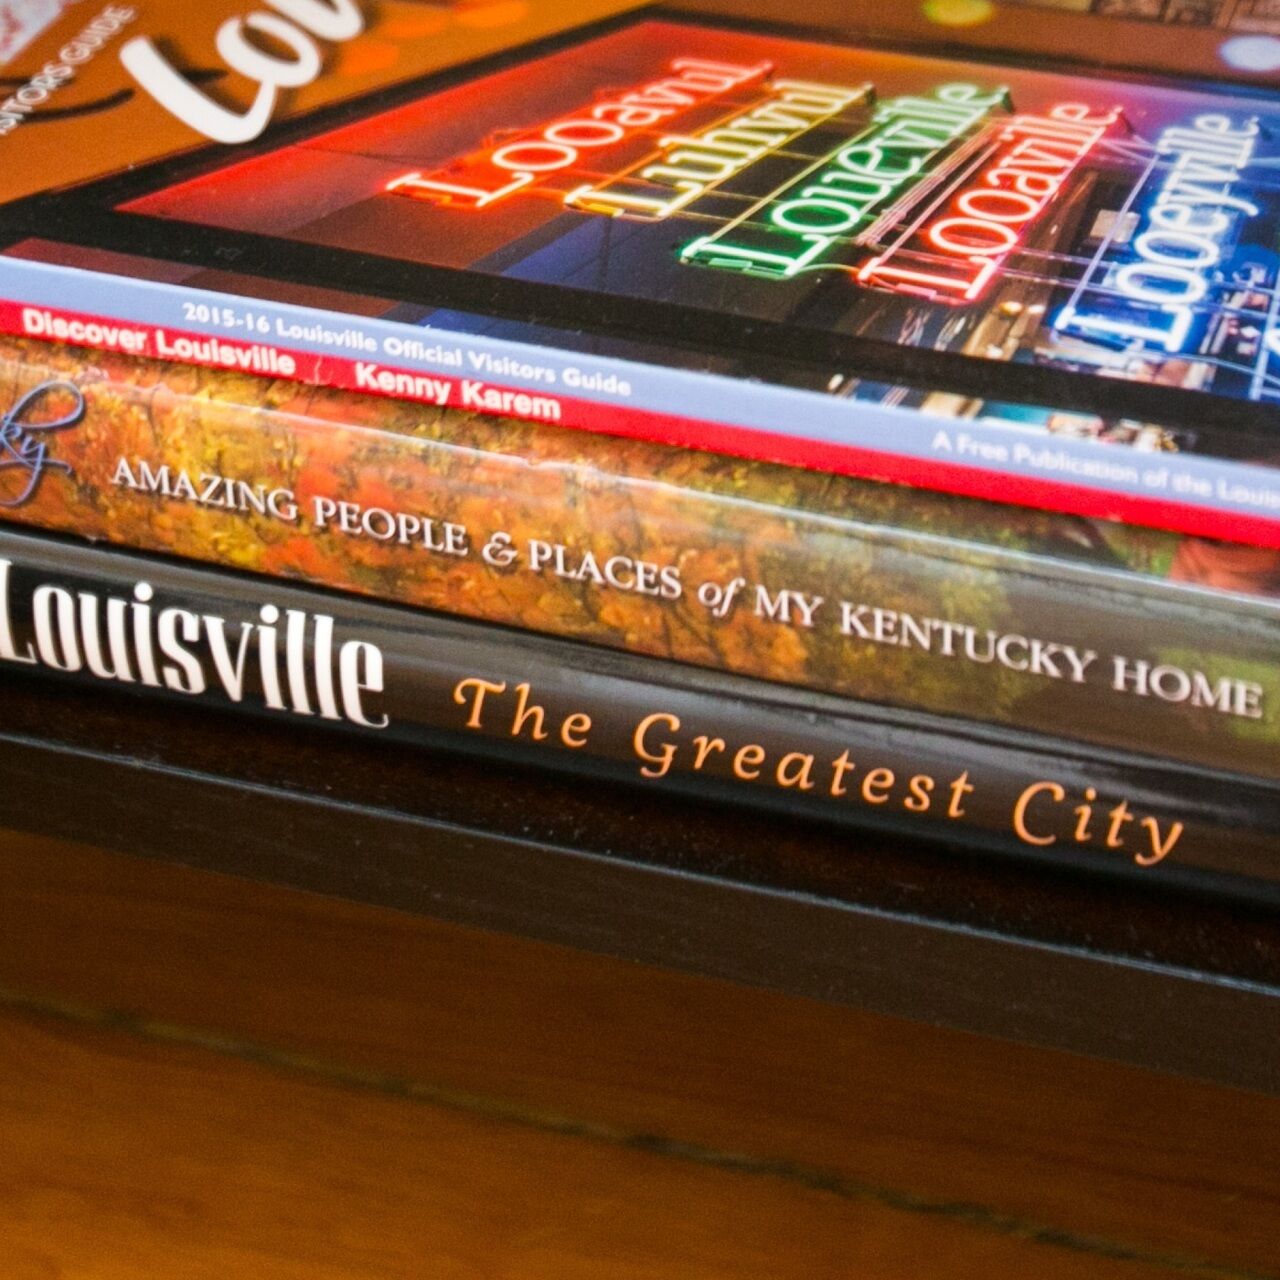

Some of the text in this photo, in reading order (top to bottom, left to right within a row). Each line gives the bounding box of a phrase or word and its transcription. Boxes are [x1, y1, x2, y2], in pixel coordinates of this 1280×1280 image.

[60, 4, 138, 64] GUIDE
[21, 308, 296, 376] Discover Louisville
[184, 302, 632, 397] 2015-16 Louisville Official Visitors Guide
[355, 361, 561, 421] Kenny Karem
[932, 430, 952, 451] A
[958, 434, 1008, 462] Free
[1013, 442, 1138, 485] Publication
[1142, 466, 1169, 488] of
[1173, 473, 1212, 497] the
[111, 455, 1263, 720] AMAZING PEOPLE & PLACES of MY KENTUCKY HOME
[453, 677, 1186, 867] The Greatest City
